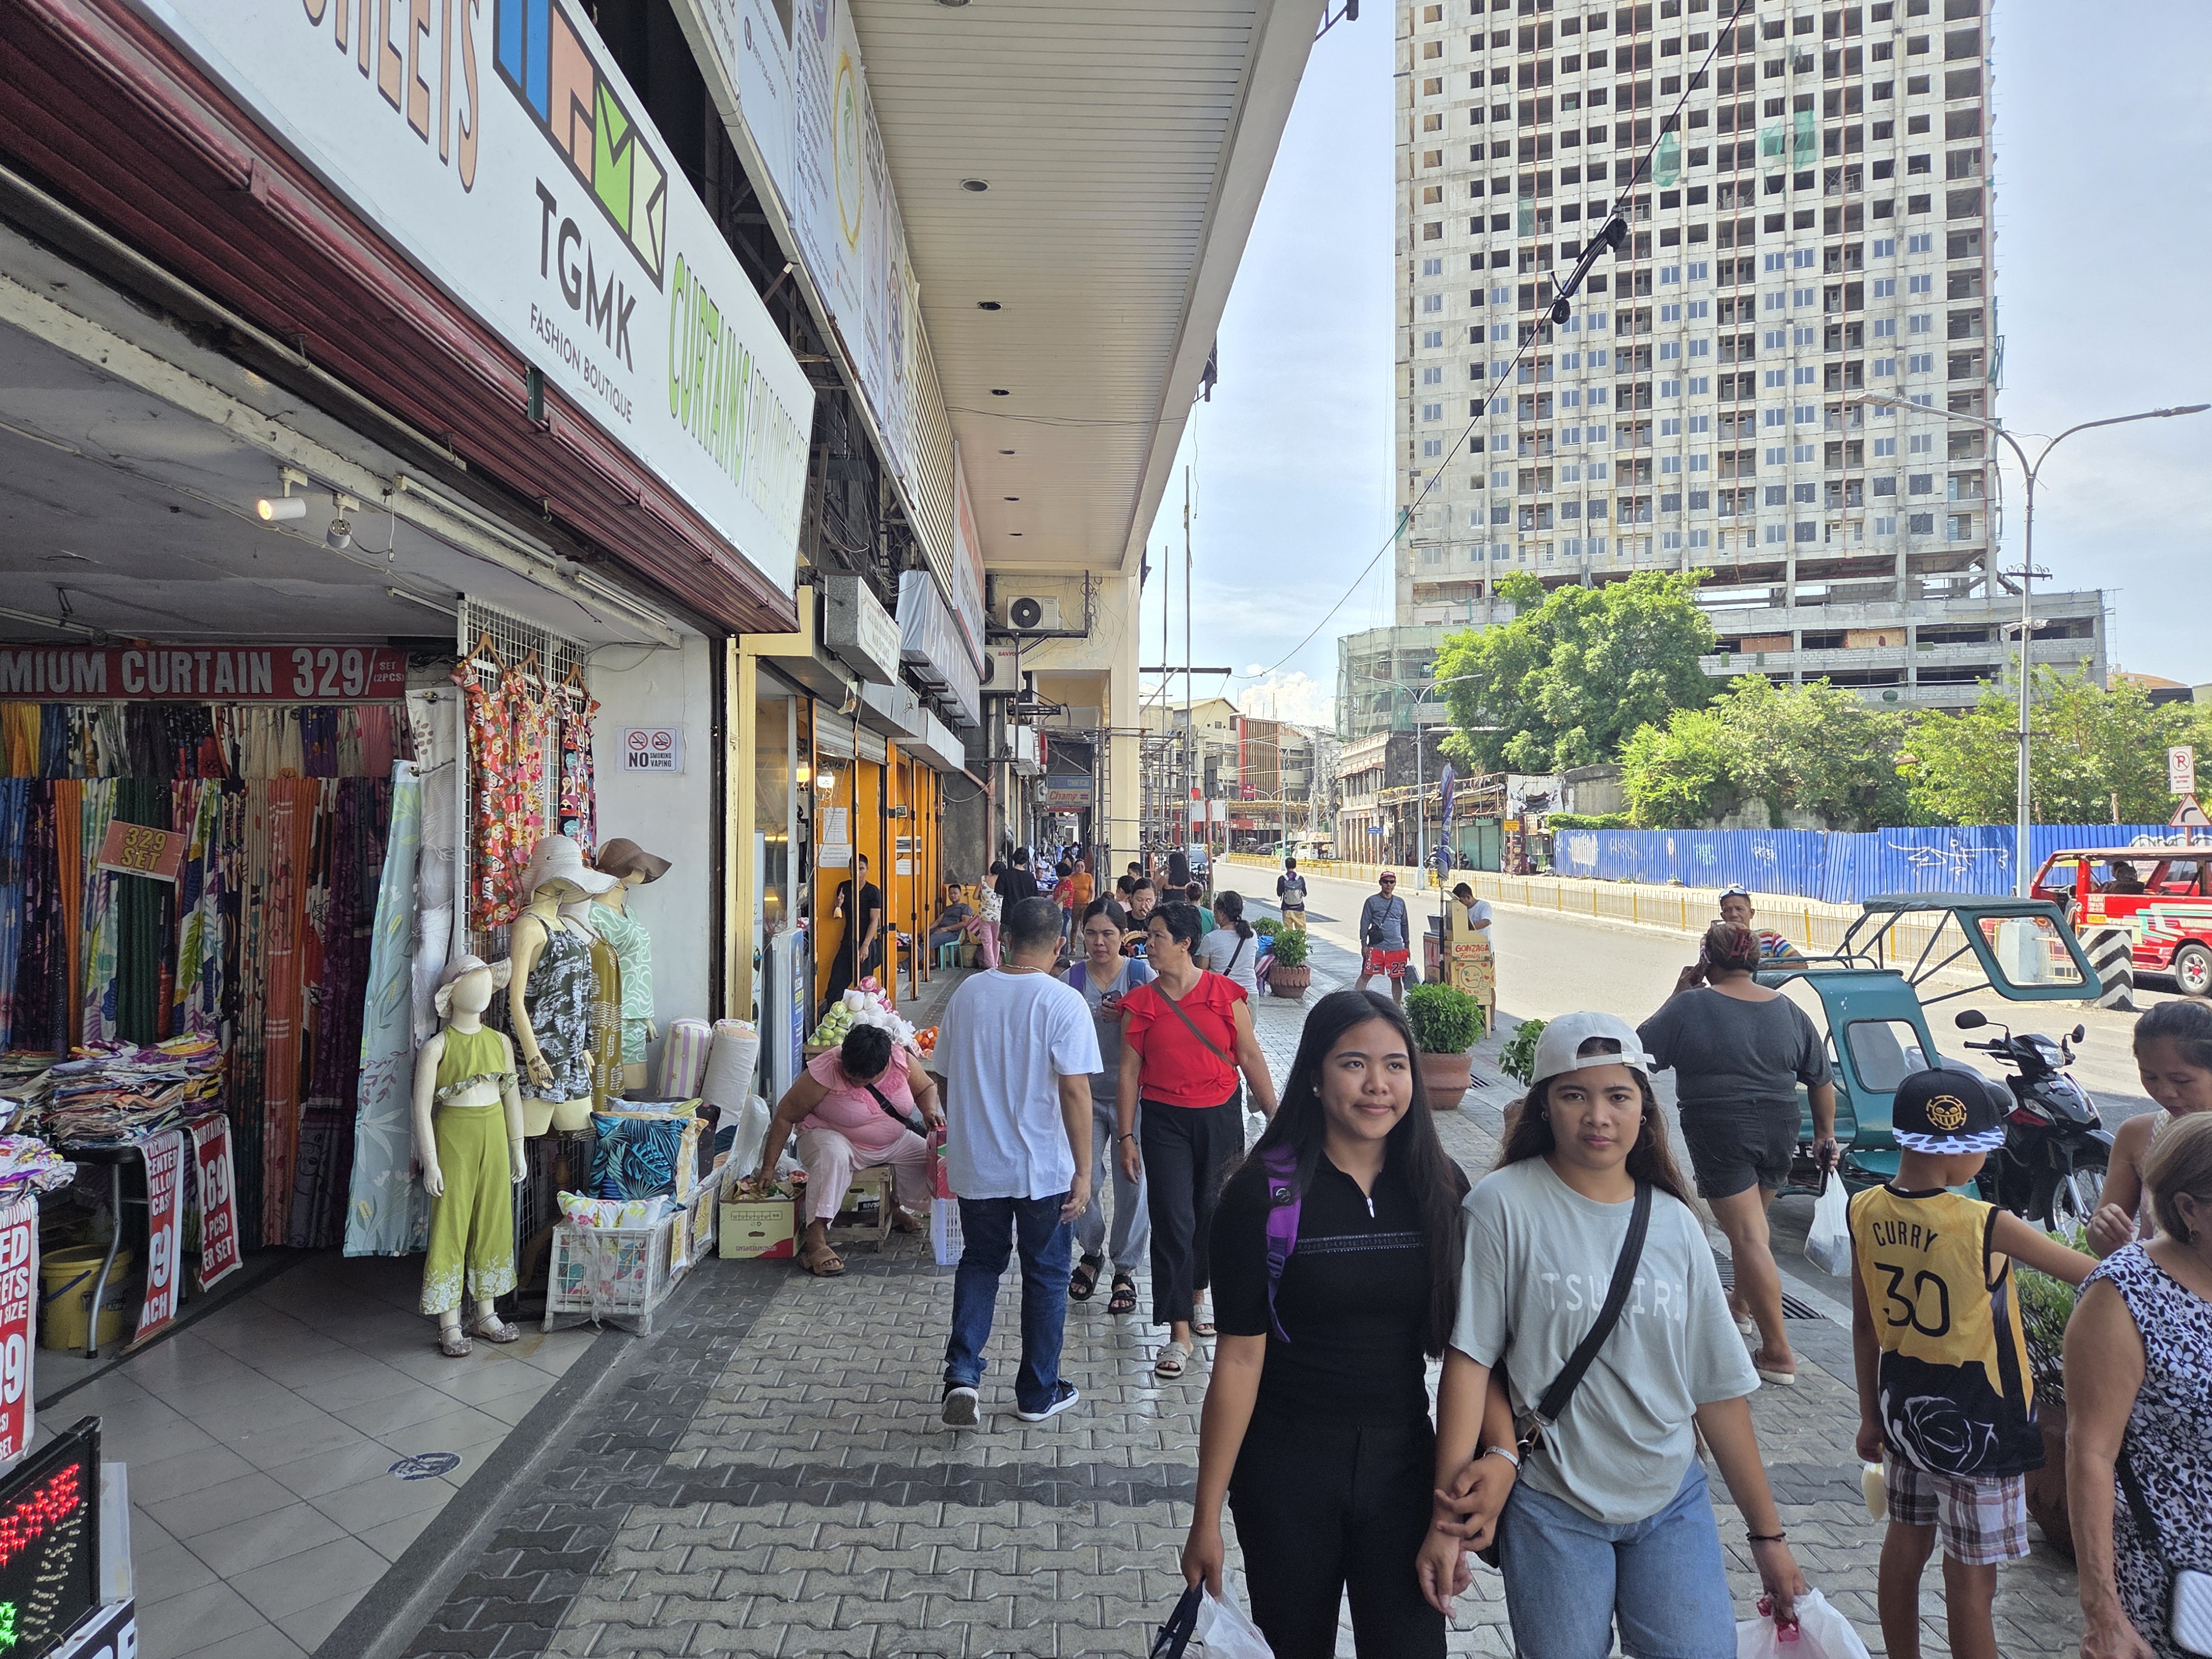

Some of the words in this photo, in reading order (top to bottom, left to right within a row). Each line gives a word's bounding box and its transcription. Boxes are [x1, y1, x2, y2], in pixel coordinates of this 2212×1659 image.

[536, 176, 637, 374] TGMK
[530, 301, 581, 375] FASHION
[584, 356, 633, 425] BOUTIQUE
[669, 252, 750, 487] CURTAINS
[122, 650, 273, 694] CURTAIN
[373, 674, 405, 684] (2PCS)
[379, 661, 395, 671] SET
[629, 752, 649, 768] NO
[1049, 791, 1078, 804] Champ
[125, 826, 168, 852] 329
[120, 846, 161, 871] SET
[1455, 944, 1489, 953] GONZAGA
[215, 1235, 232, 1262] SET
[1872, 1220, 1939, 1253] CURRY
[0, 1266, 29, 1307] ETS
[1540, 1272, 1682, 1321] TSUIRI
[1873, 1261, 1950, 1338] 30
[4, 1300, 27, 1324] SIZE
